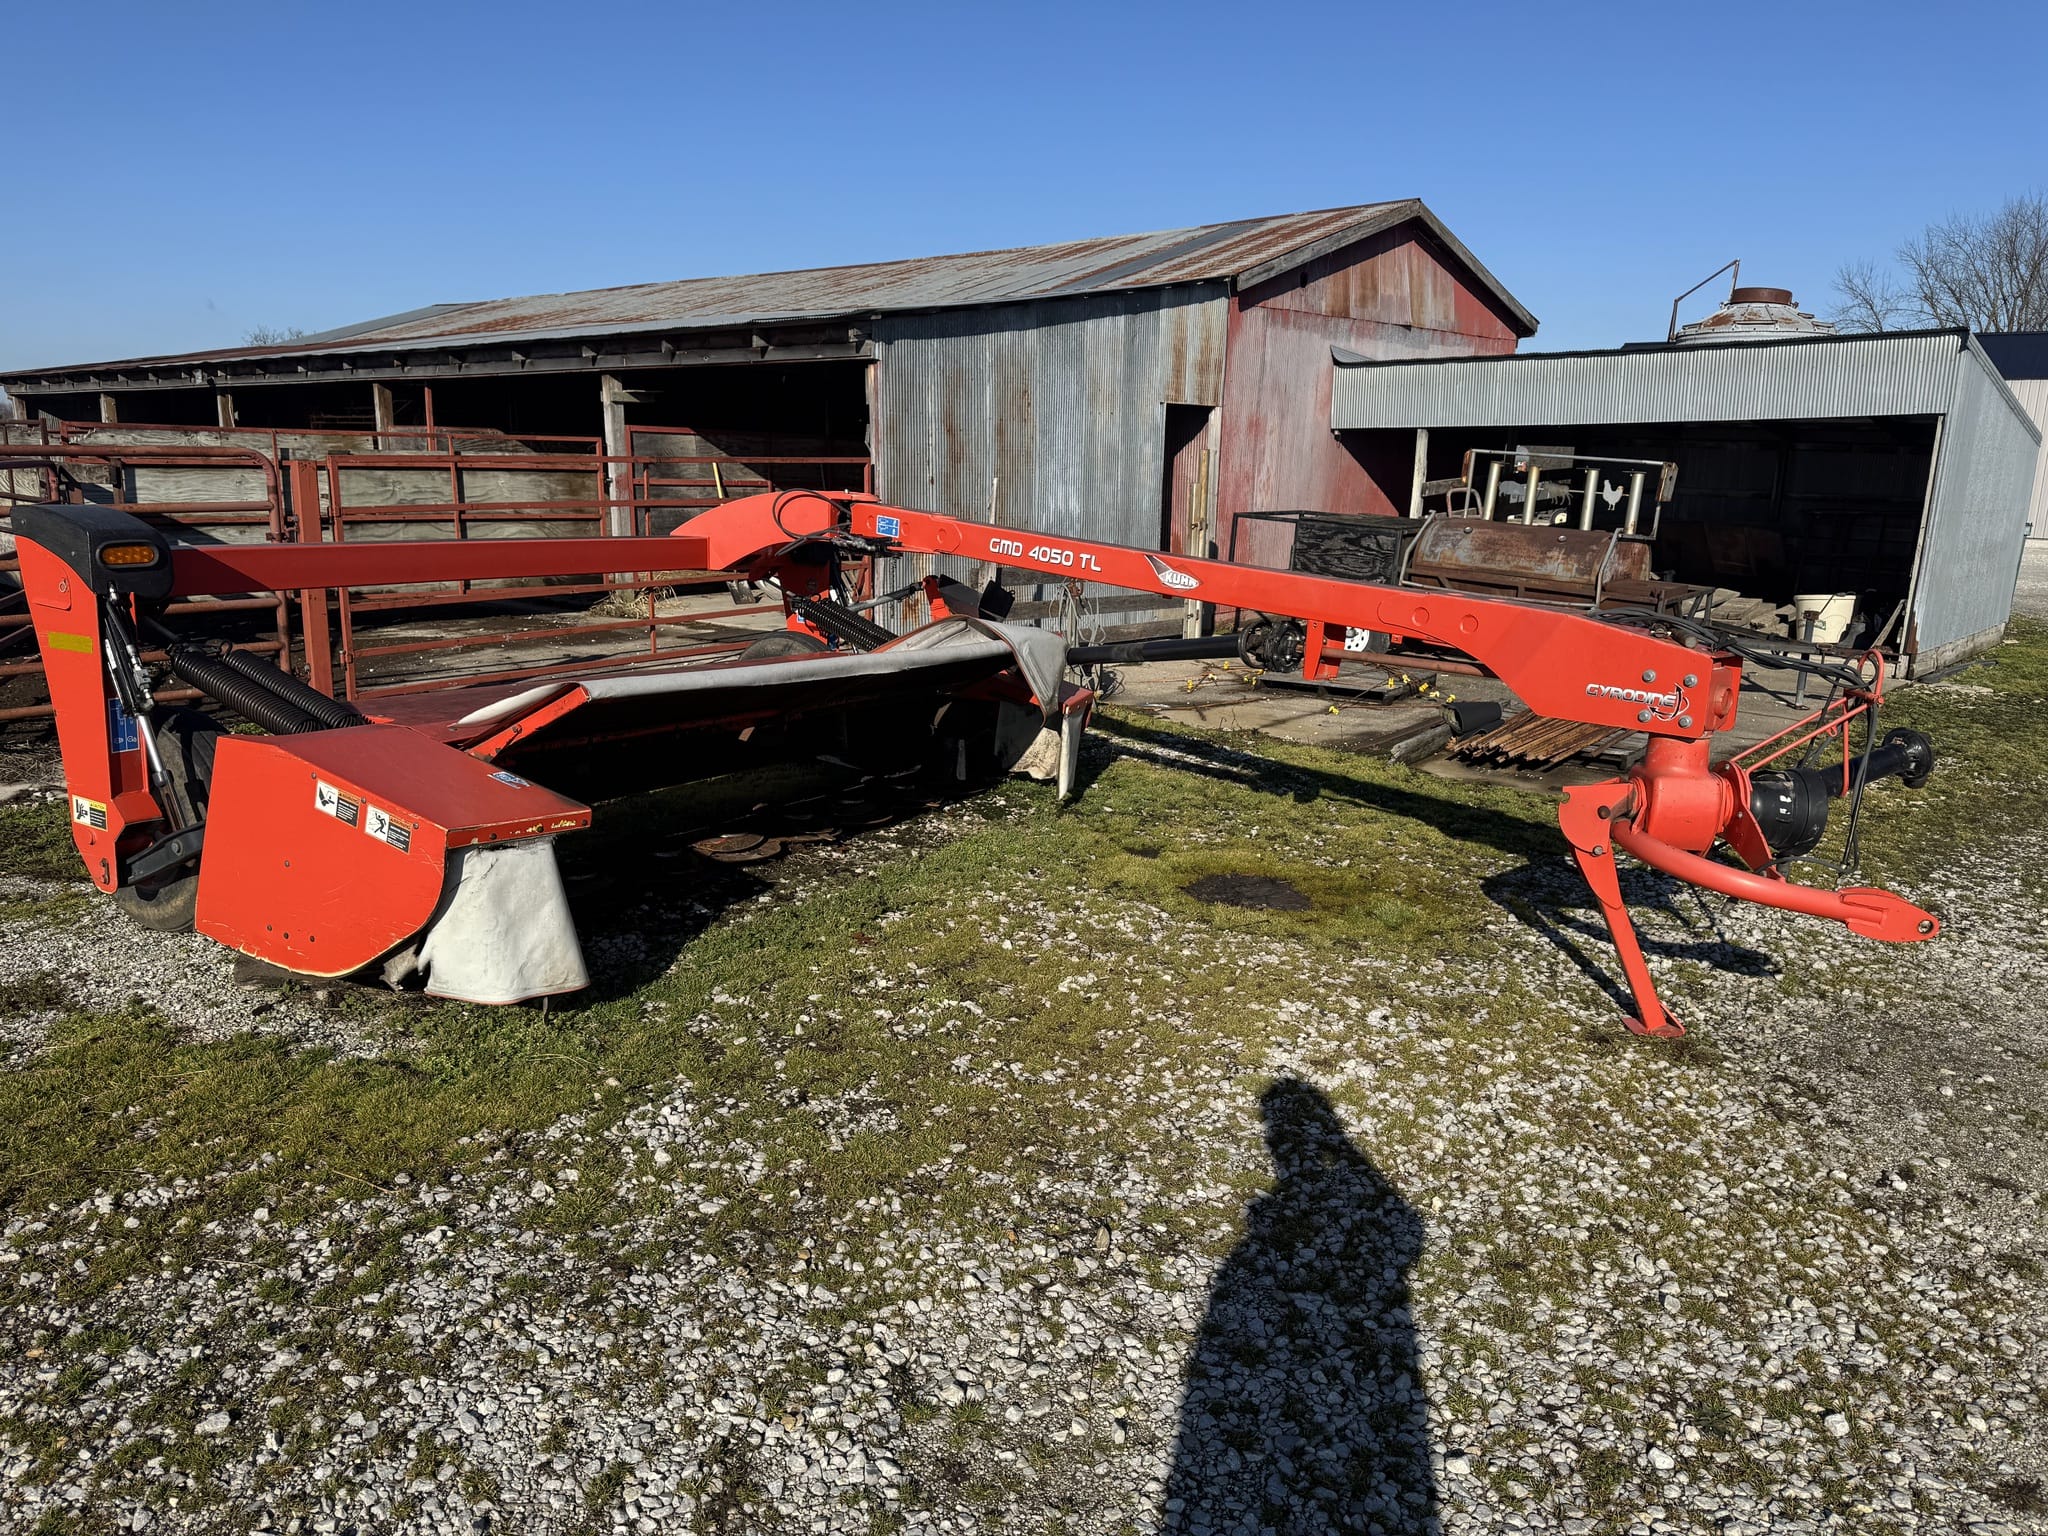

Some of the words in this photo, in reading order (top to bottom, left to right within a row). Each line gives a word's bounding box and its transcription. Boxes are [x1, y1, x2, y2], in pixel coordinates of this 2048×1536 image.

[989, 538, 1023, 557] GMD
[1029, 545, 1074, 567] 4050
[1079, 553, 1102, 572] TL
[1165, 572, 1197, 587] KUHN
[1586, 683, 1677, 708] GYRODINE
